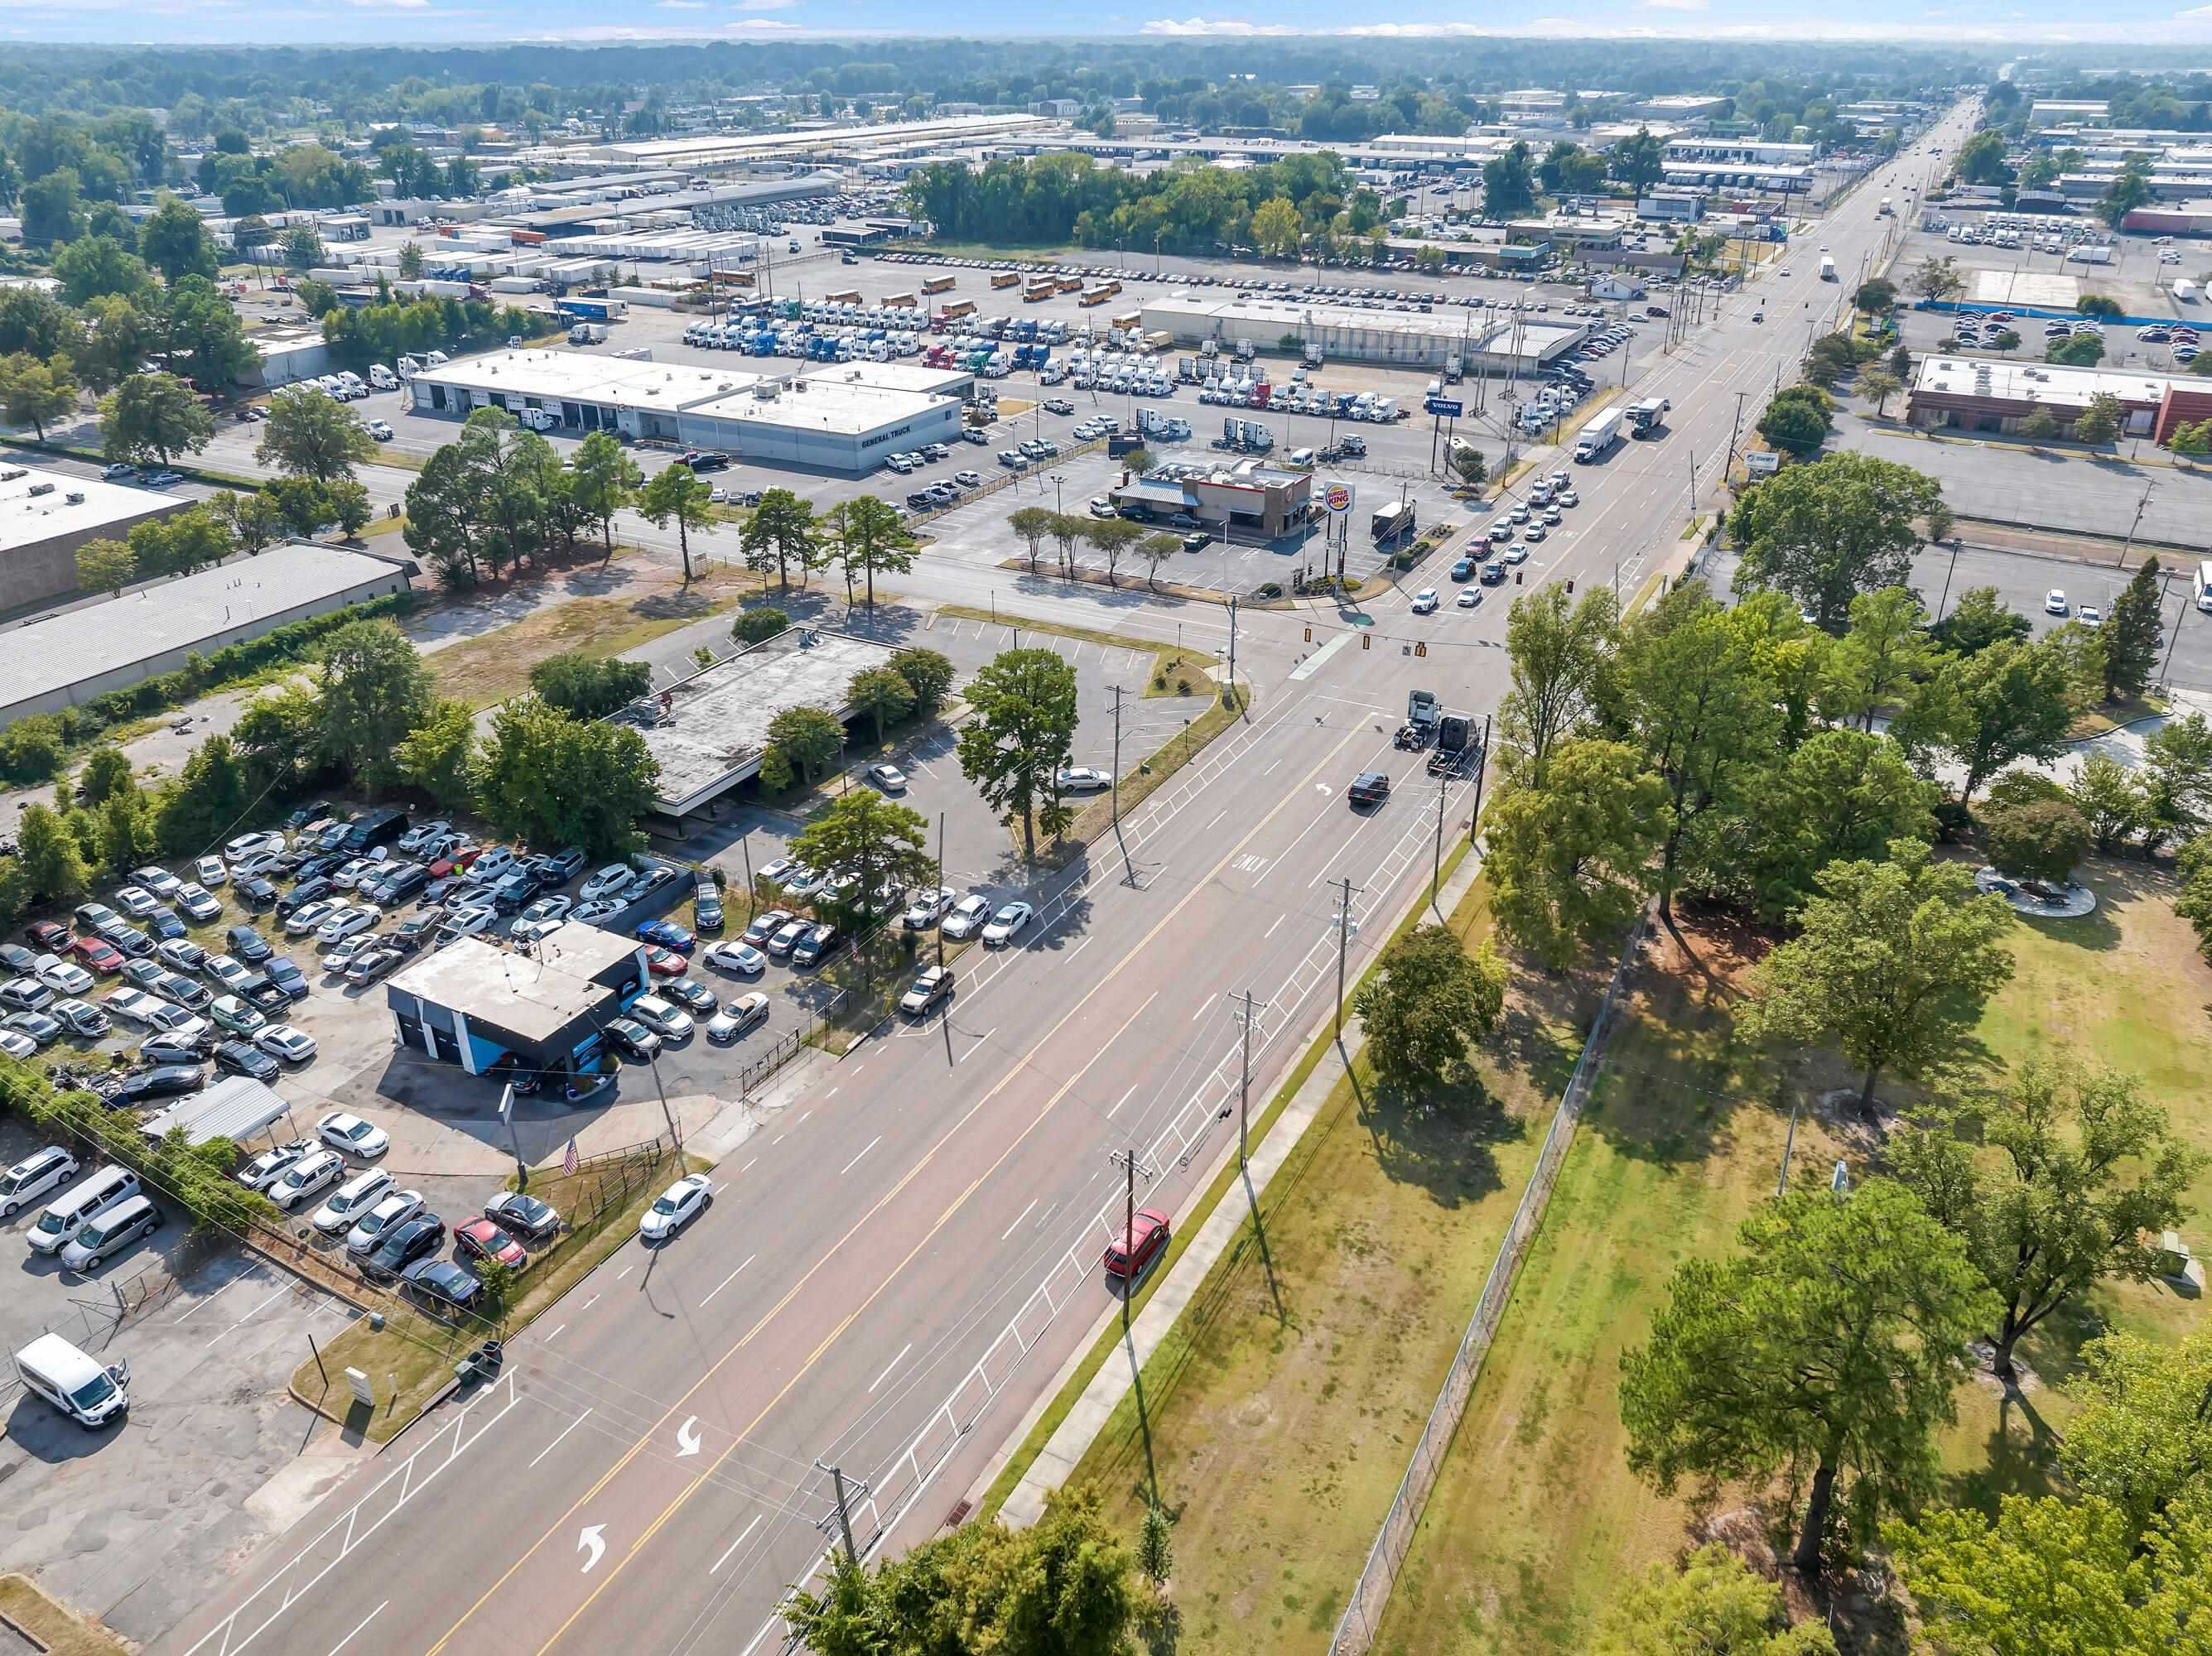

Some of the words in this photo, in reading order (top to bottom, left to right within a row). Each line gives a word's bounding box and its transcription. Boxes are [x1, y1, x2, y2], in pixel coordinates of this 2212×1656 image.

[862, 433, 889, 449] GENERAL
[891, 424, 912, 438] TRUCK
[1328, 489, 1348, 498] BURGER
[1328, 495, 1349, 504] KING
[1231, 854, 1268, 873] ONLY
